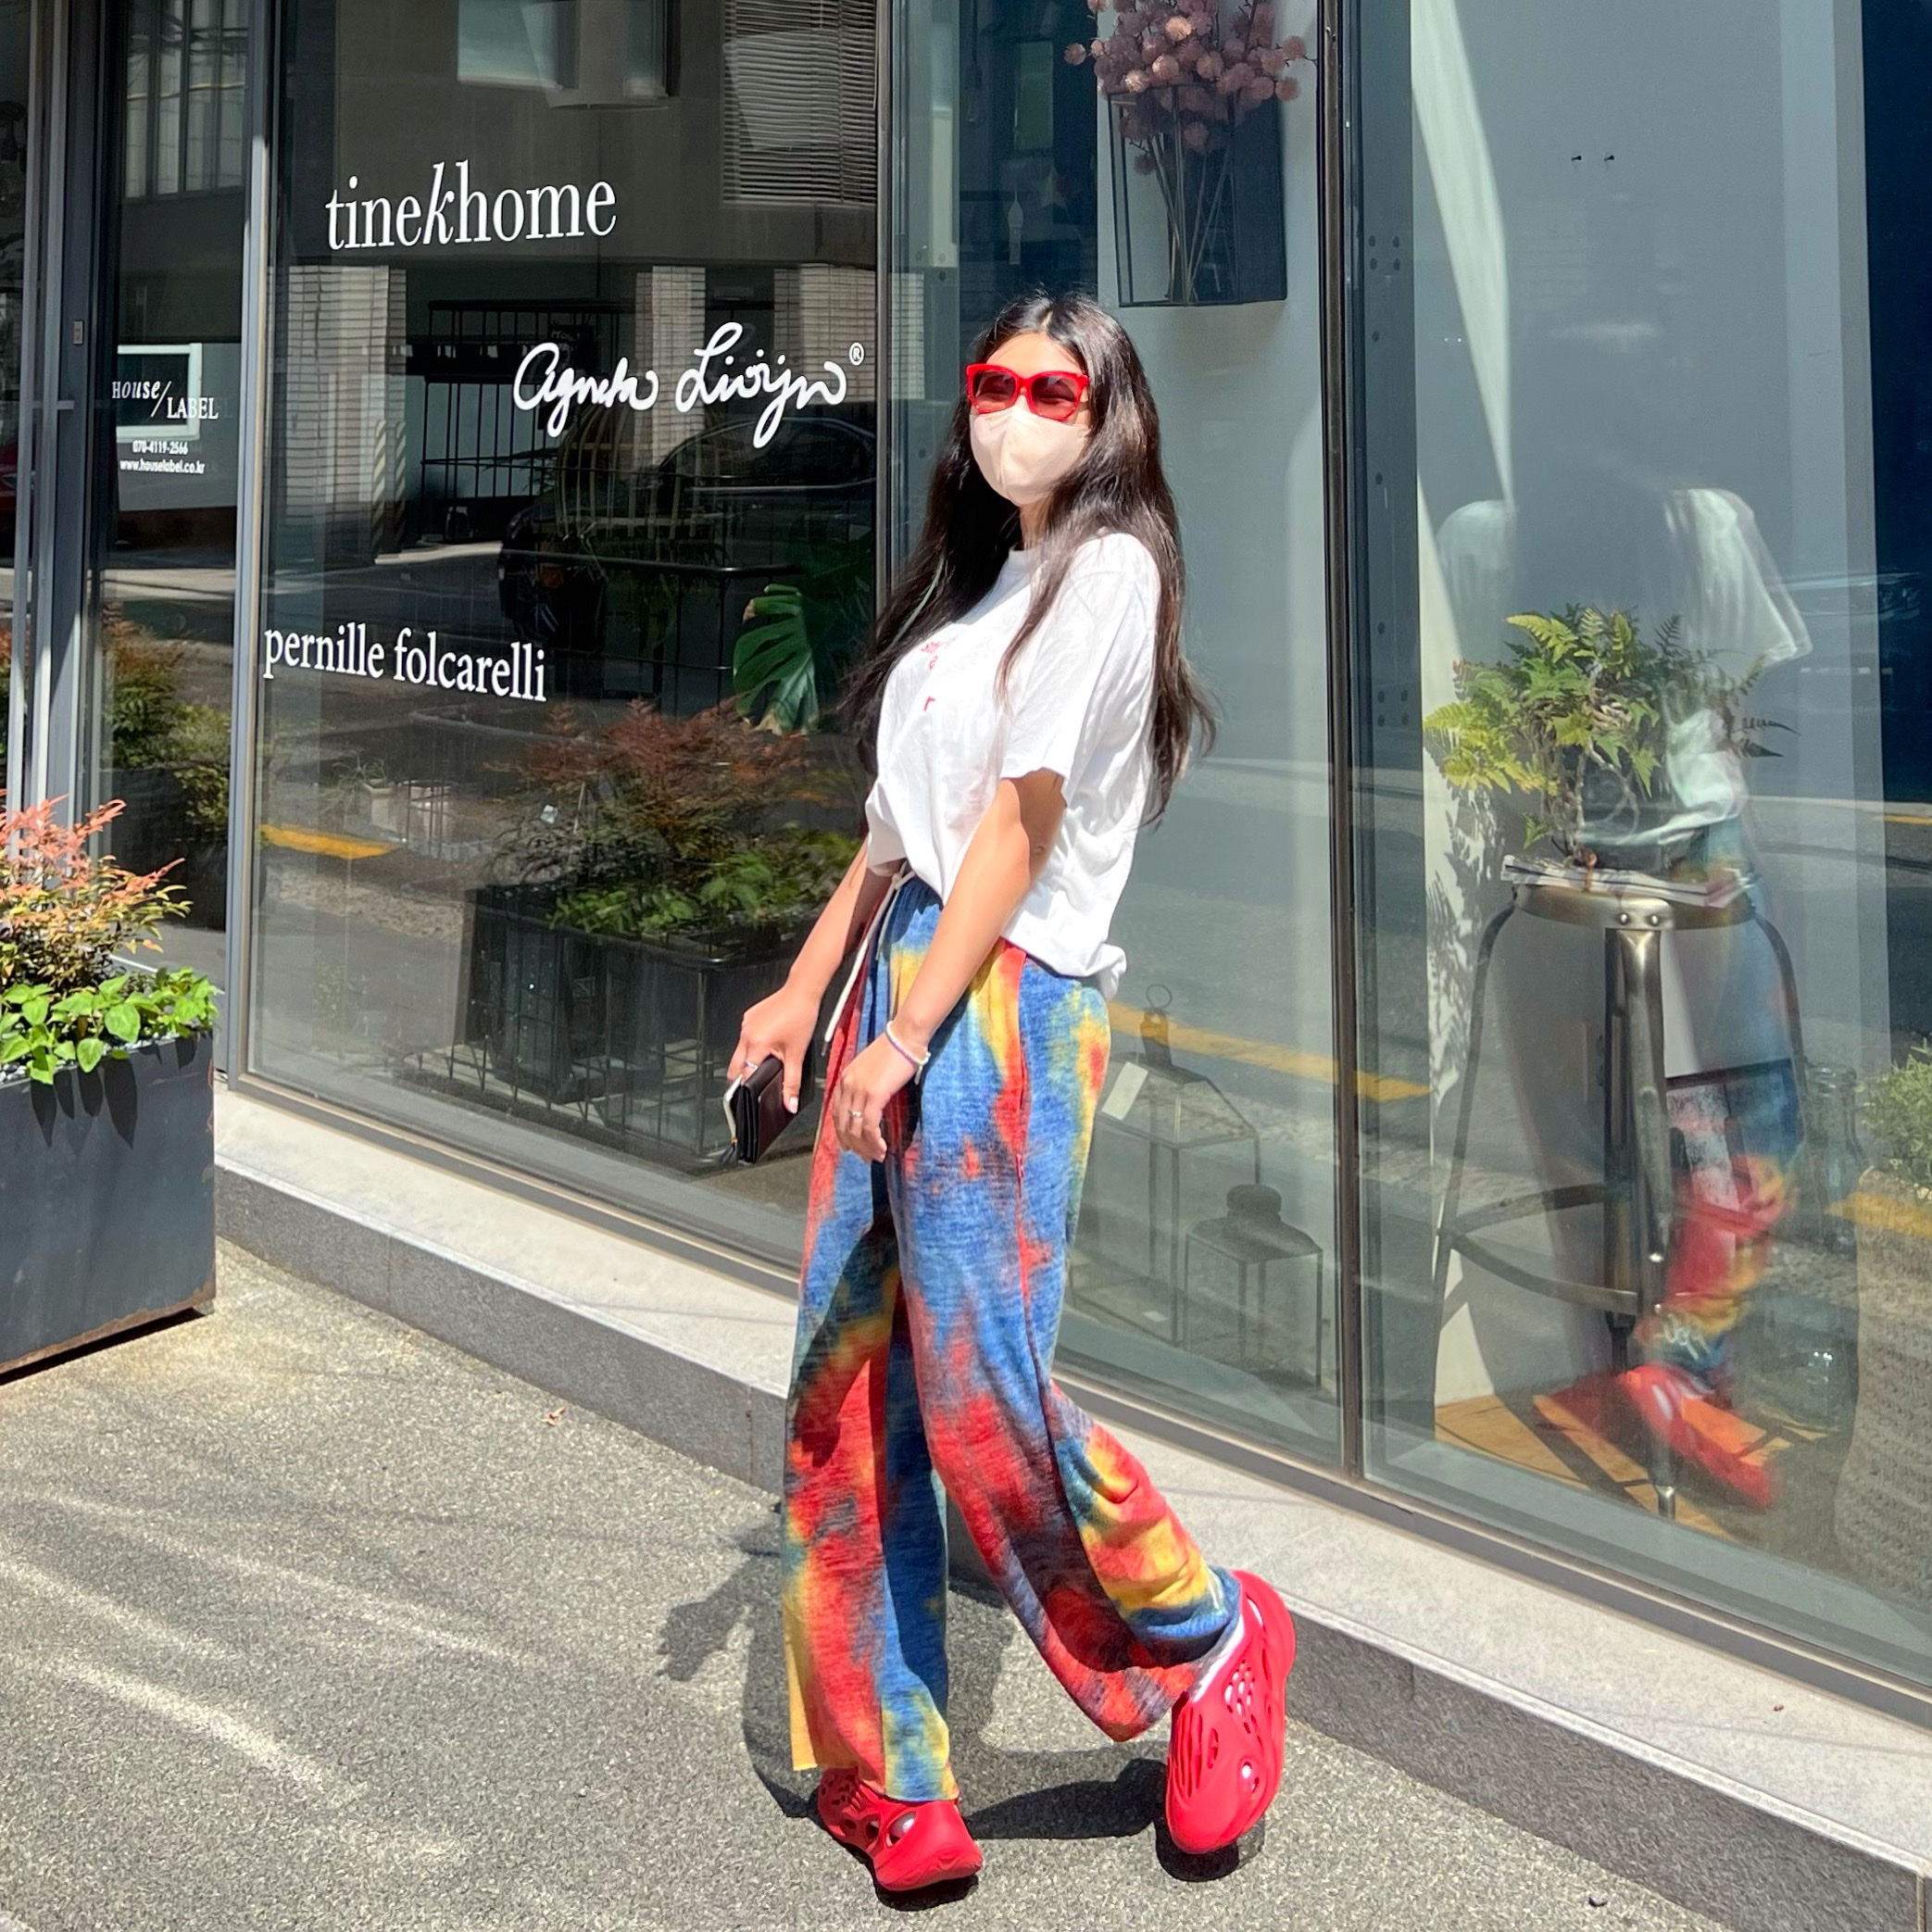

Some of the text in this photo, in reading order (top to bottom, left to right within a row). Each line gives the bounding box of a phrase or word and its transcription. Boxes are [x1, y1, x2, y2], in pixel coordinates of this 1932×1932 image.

[325, 159, 617, 250] tinekhome
[167, 396, 219, 420] LABEL
[119, 458, 206, 474] www.houselabel.co.kr
[262, 621, 546, 702] pernille folcarelli
